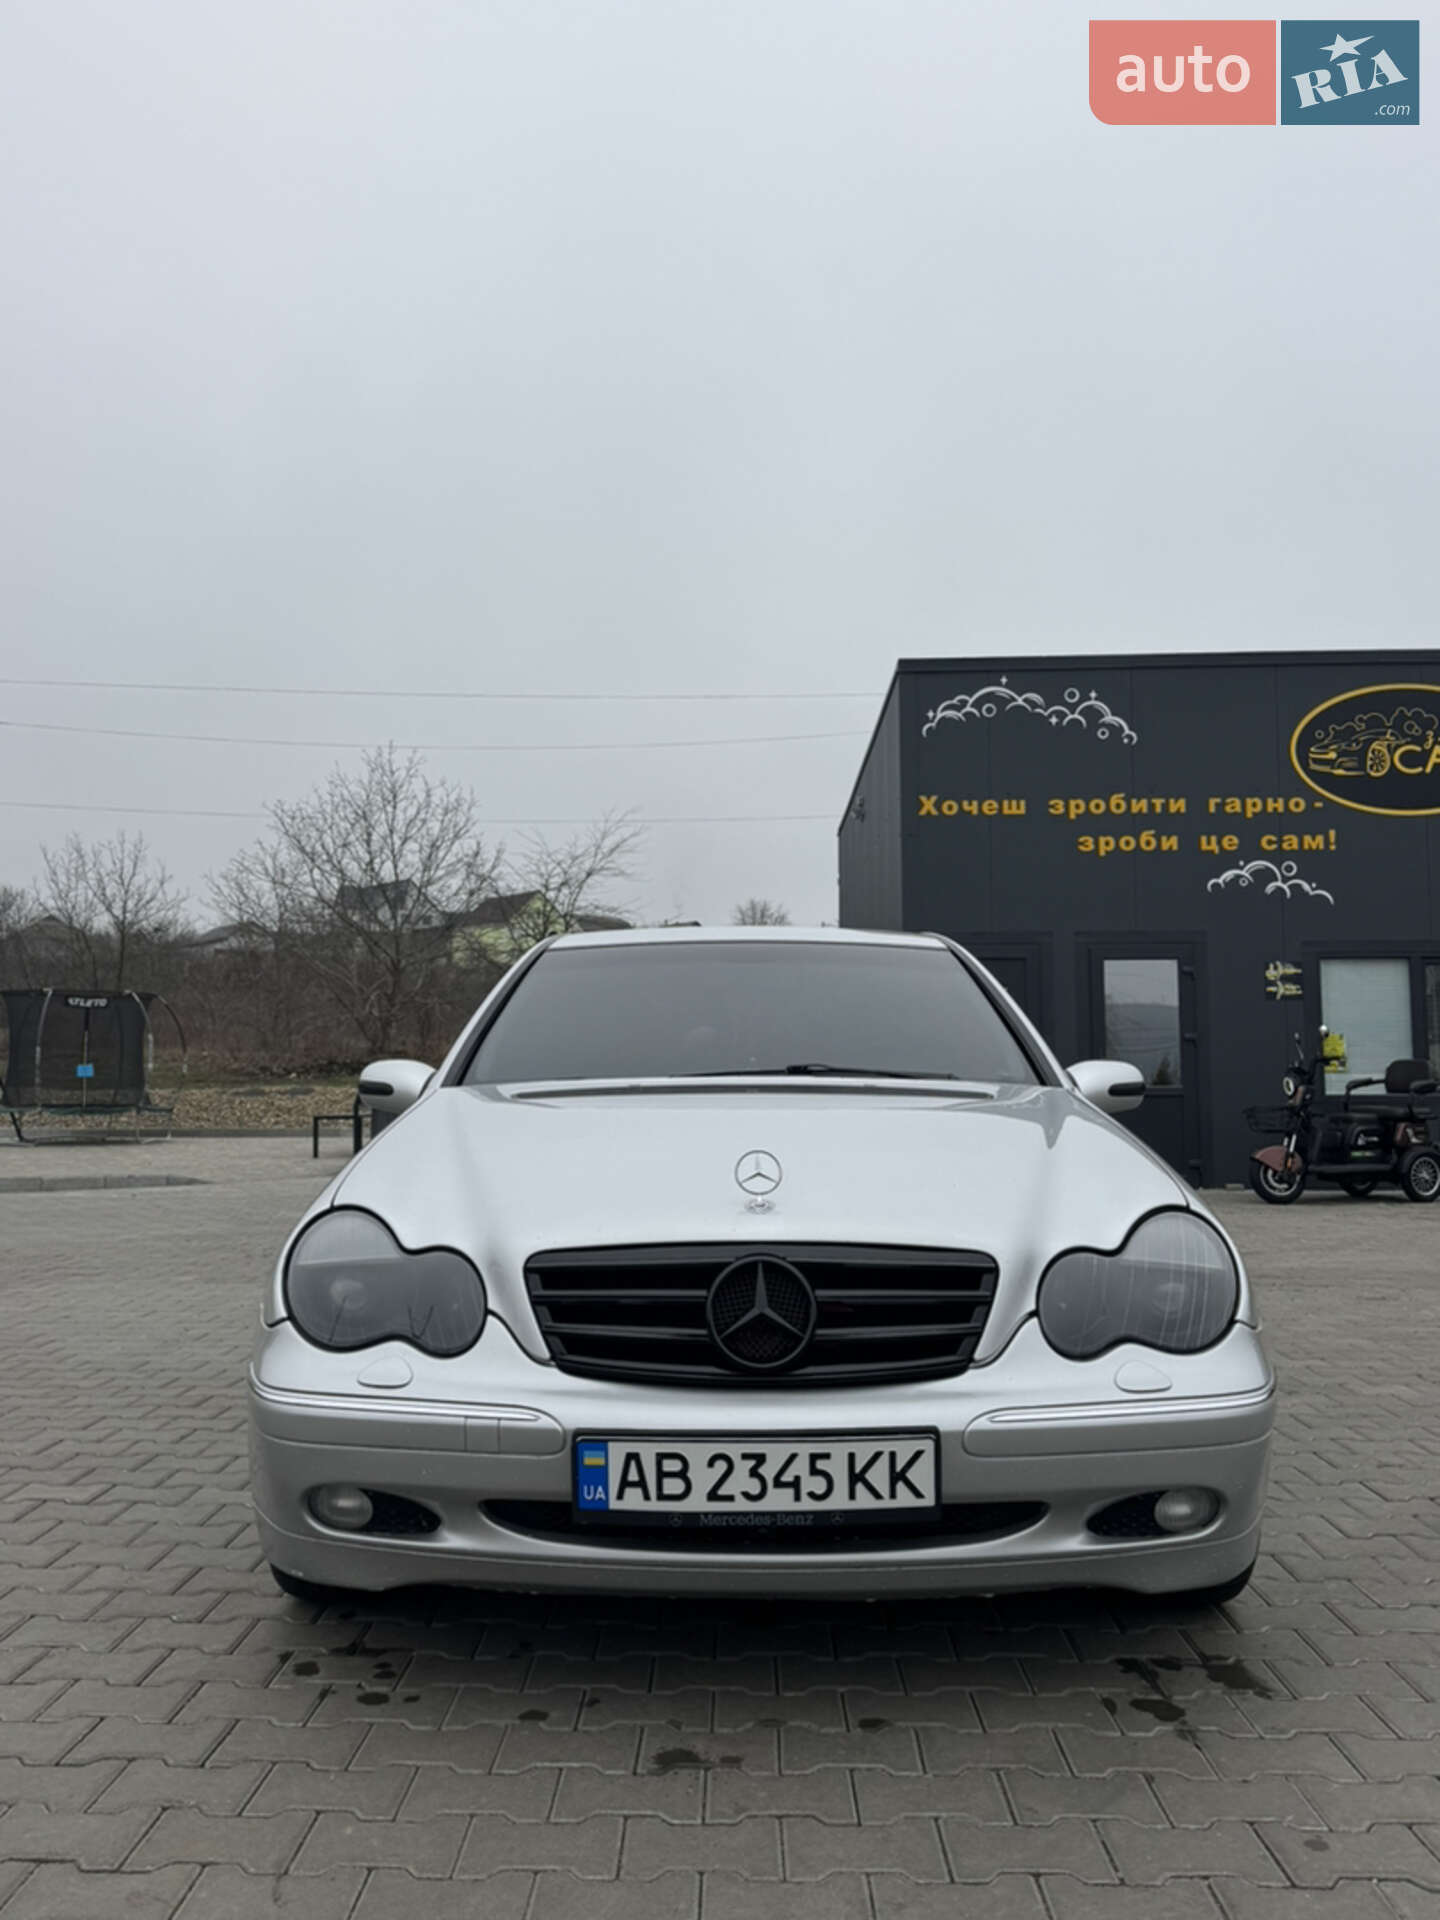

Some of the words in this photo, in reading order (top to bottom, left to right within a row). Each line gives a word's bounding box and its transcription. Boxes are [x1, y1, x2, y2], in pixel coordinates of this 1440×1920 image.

[918, 795, 1027, 816] Хочеш
[1048, 793, 1187, 820] зробити
[1077, 829, 1179, 857] зроби
[1200, 835, 1240, 855] це
[1260, 828, 1337, 851] сам!
[615, 1452, 693, 1502] AB
[706, 1452, 834, 1503] 2345
[846, 1449, 926, 1501] KK
[583, 1484, 606, 1500] UA
[699, 1513, 815, 1527] Mercedes-Benz
